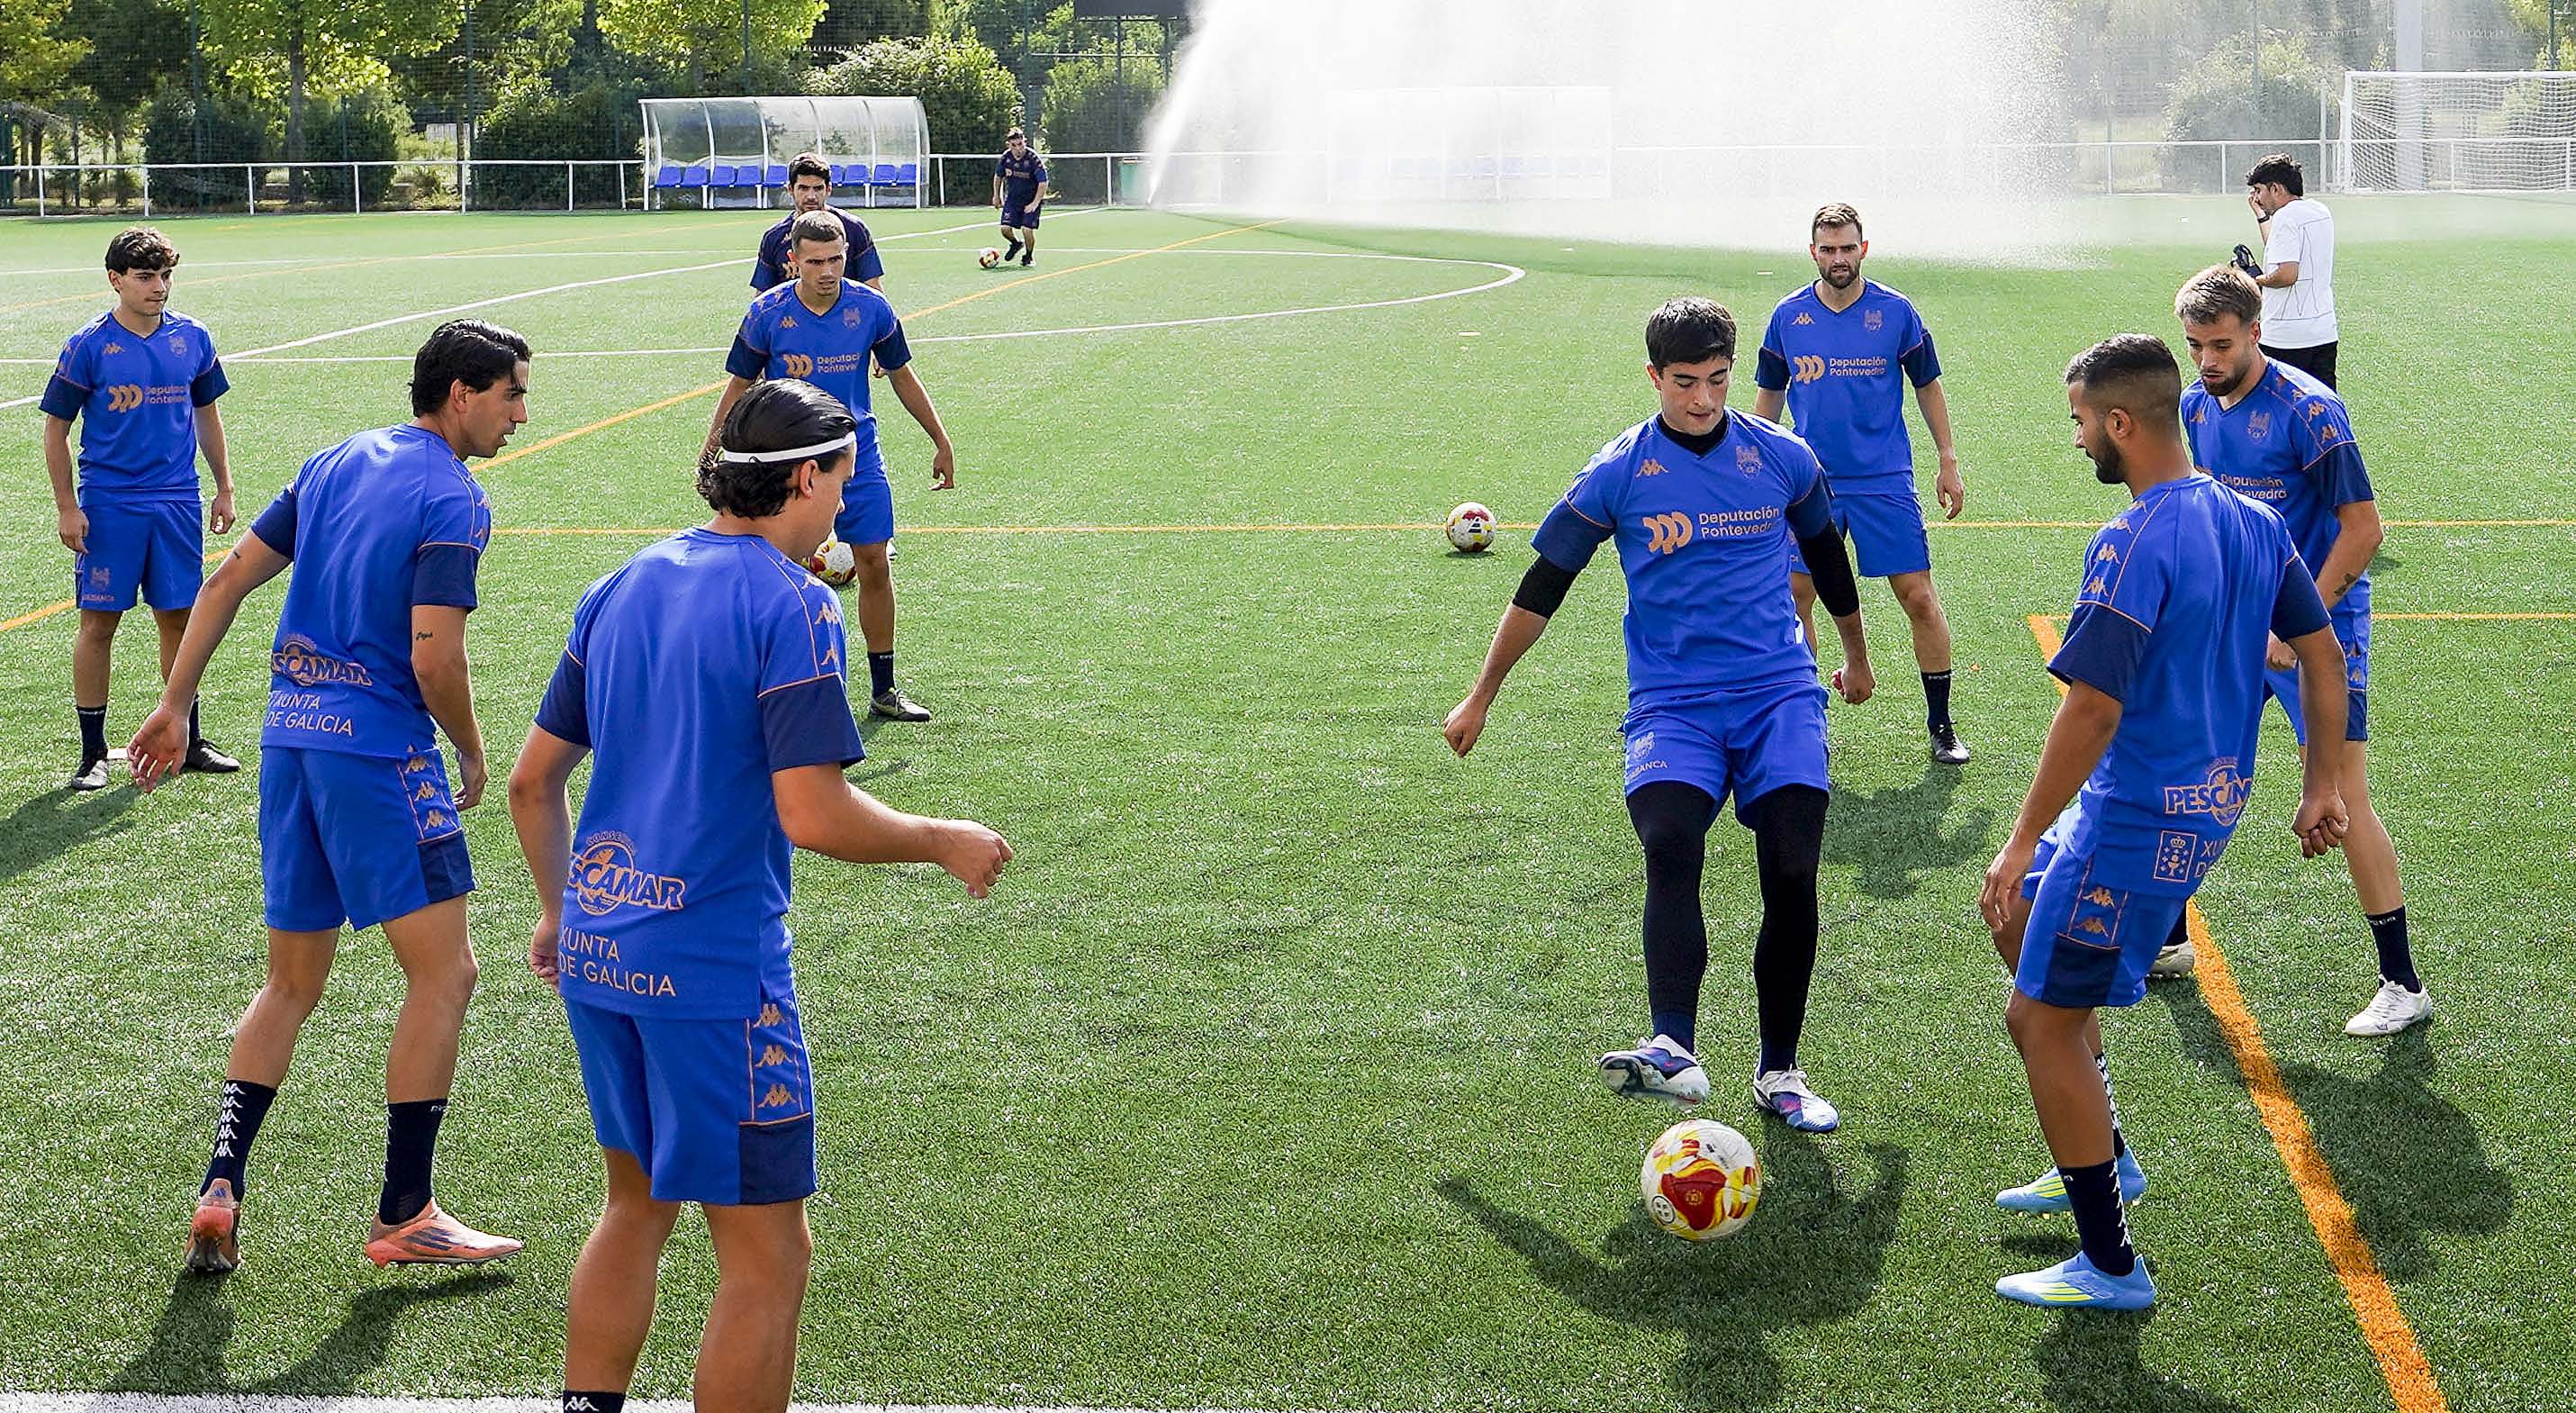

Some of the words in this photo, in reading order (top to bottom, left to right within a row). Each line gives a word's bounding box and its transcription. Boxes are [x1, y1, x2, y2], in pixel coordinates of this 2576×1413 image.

[1830, 357, 1887, 367] Deputación
[1699, 505, 1779, 527] Deputación
[267, 711, 284, 727] DE
[285, 711, 353, 737] GALICIA
[558, 951, 577, 977] DE
[583, 961, 676, 997] GALICIA
